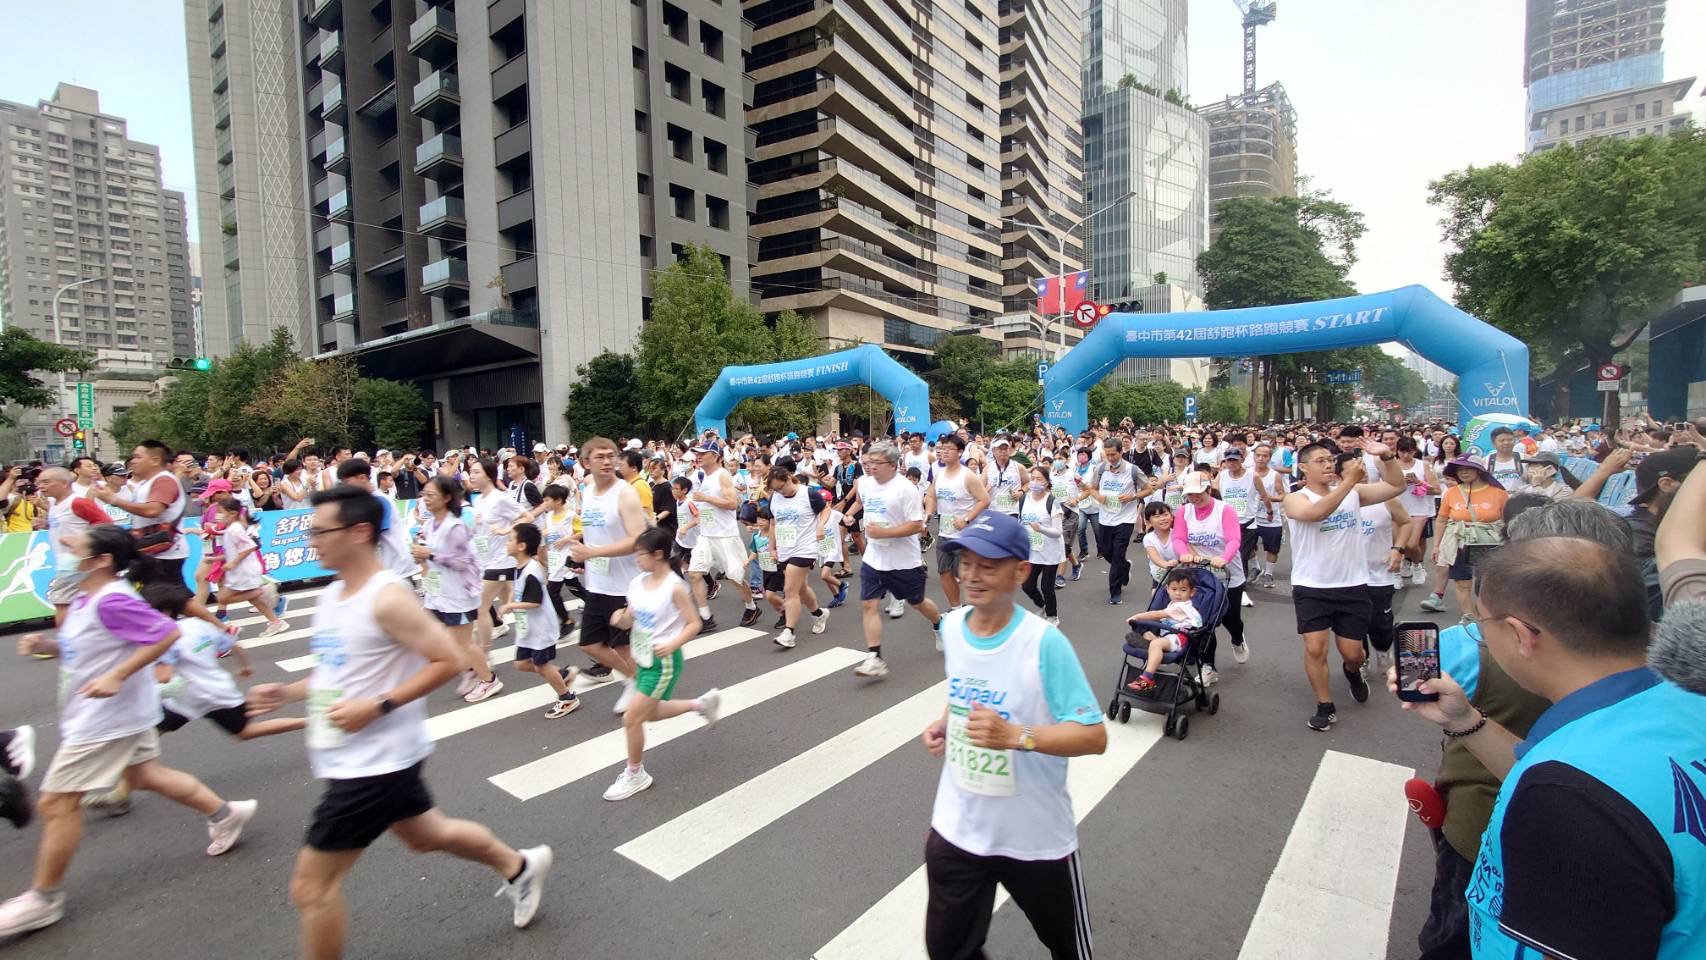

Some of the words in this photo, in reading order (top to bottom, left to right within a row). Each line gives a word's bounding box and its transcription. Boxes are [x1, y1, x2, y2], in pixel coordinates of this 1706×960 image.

[1126, 319, 1309, 342] 臺中市第42屆舒跑杯路跑競賽
[1313, 307, 1387, 330] START
[816, 361, 849, 376] FINISH
[1038, 364, 1048, 378] P
[1186, 397, 1195, 412] P
[1473, 396, 1518, 408] VITALON
[1339, 518, 1358, 530] Cup
[1187, 532, 1217, 542] Supau
[948, 678, 1009, 706] Supau
